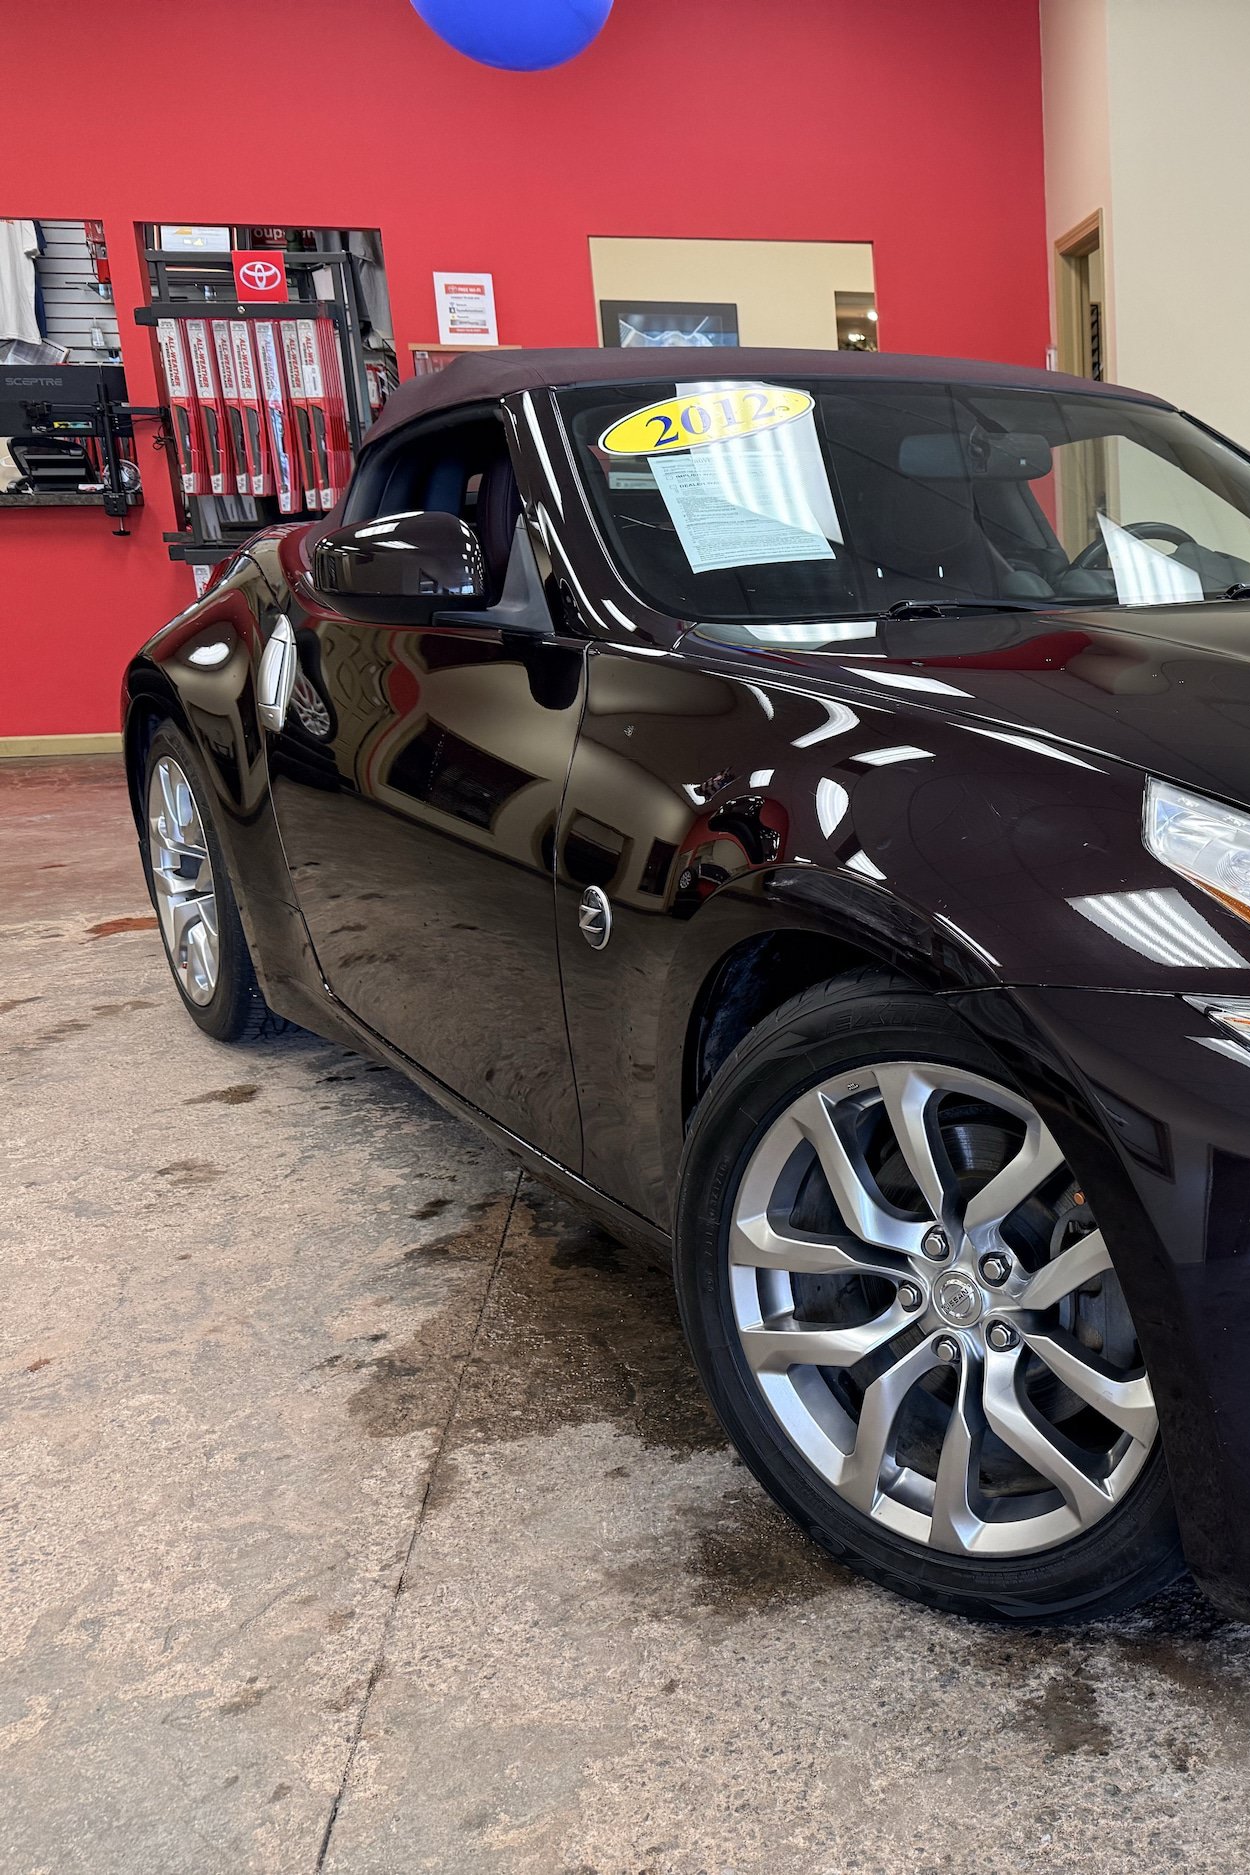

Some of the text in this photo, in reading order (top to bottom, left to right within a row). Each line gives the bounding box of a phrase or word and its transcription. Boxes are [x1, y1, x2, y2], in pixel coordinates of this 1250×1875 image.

[5, 377, 63, 386] SCEPTRE
[167, 336, 180, 386] ALL-WEATHER
[196, 338, 209, 387] ALL-WEATHER
[239, 339, 252, 388] ALL-WEATHER
[645, 392, 776, 448] 2012
[941, 1287, 969, 1314] NISSAN
